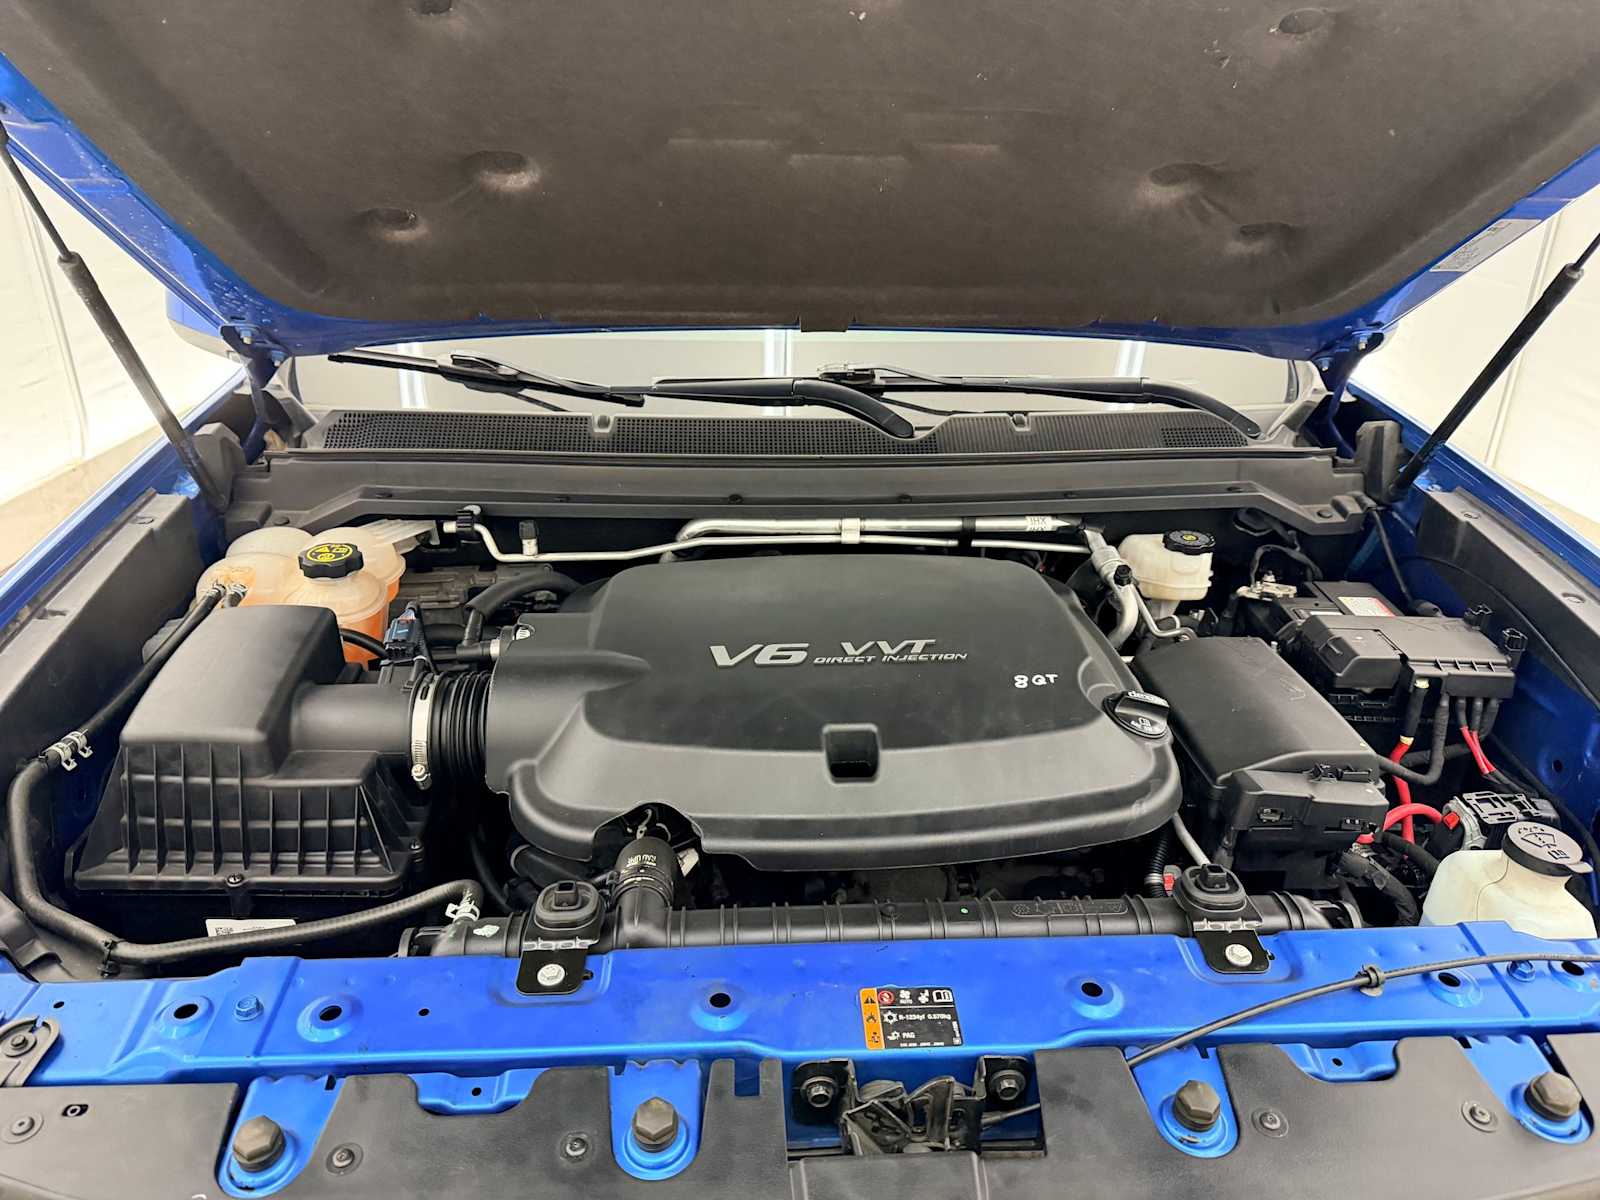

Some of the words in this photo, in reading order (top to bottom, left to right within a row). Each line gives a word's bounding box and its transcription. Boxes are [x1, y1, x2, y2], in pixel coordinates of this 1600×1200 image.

[709, 642, 810, 668] V6
[840, 639, 936, 655] VVT
[813, 655, 876, 665] DIRECT
[881, 653, 968, 663] INJECTION
[1013, 674, 1028, 689] 8
[1031, 673, 1058, 687] QT
